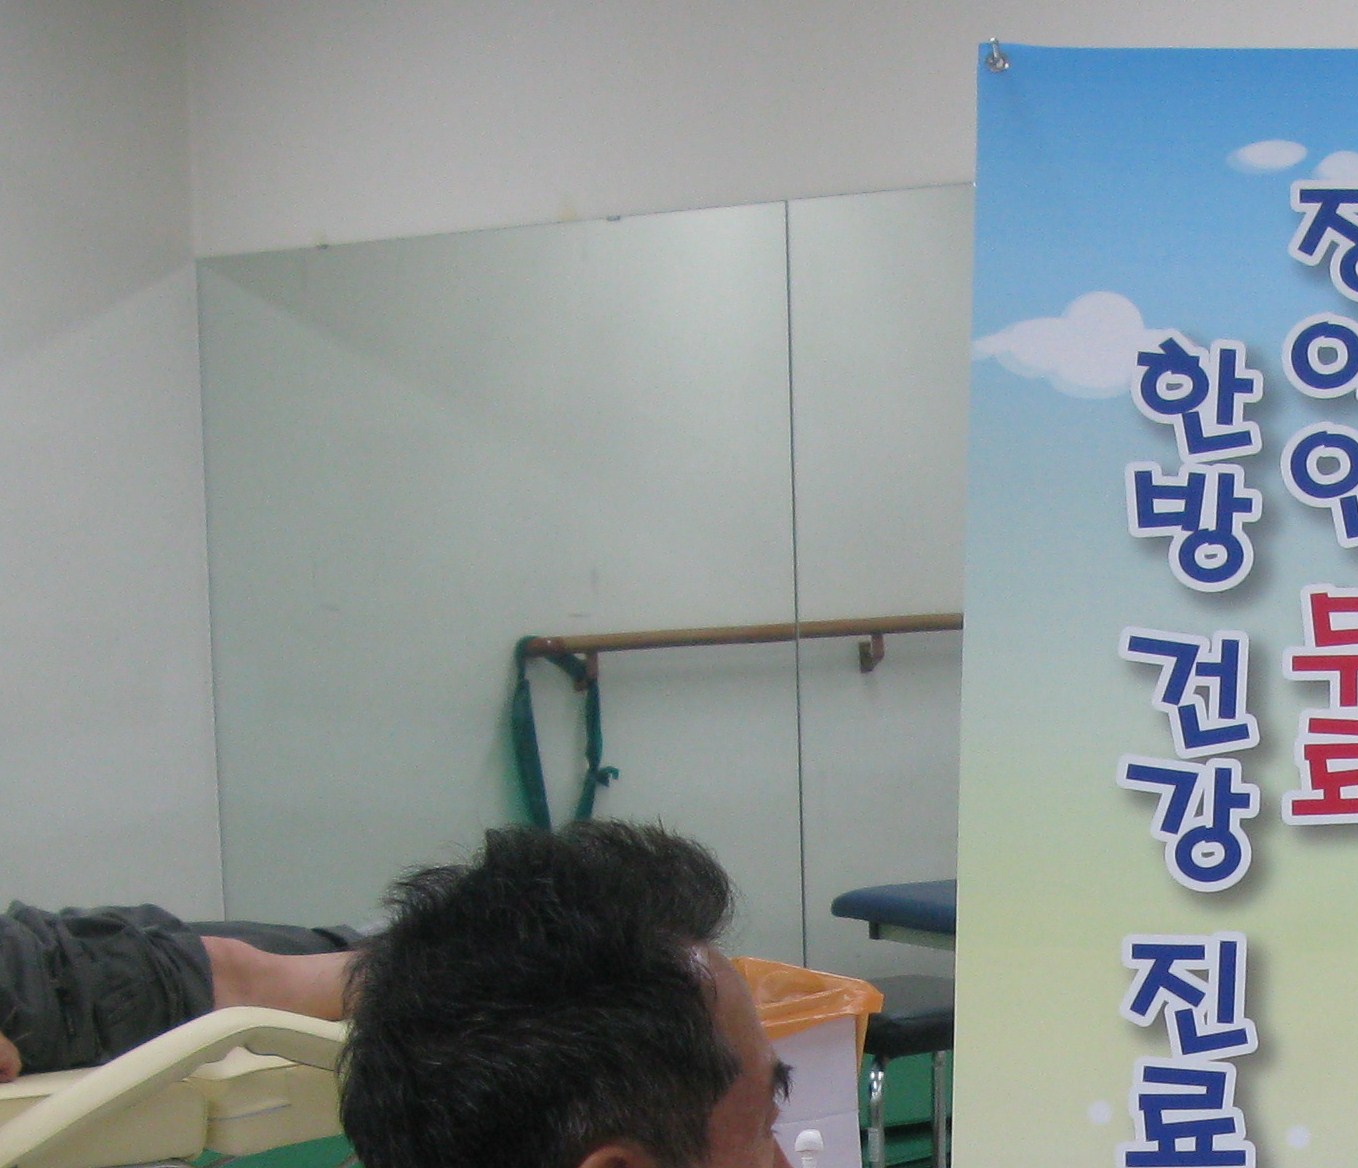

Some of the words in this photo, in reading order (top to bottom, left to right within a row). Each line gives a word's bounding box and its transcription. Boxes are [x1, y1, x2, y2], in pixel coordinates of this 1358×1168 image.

[1135, 336, 1256, 585] 한방
[1127, 635, 1253, 885] 건강
[1124, 940, 1249, 1168] 진료
